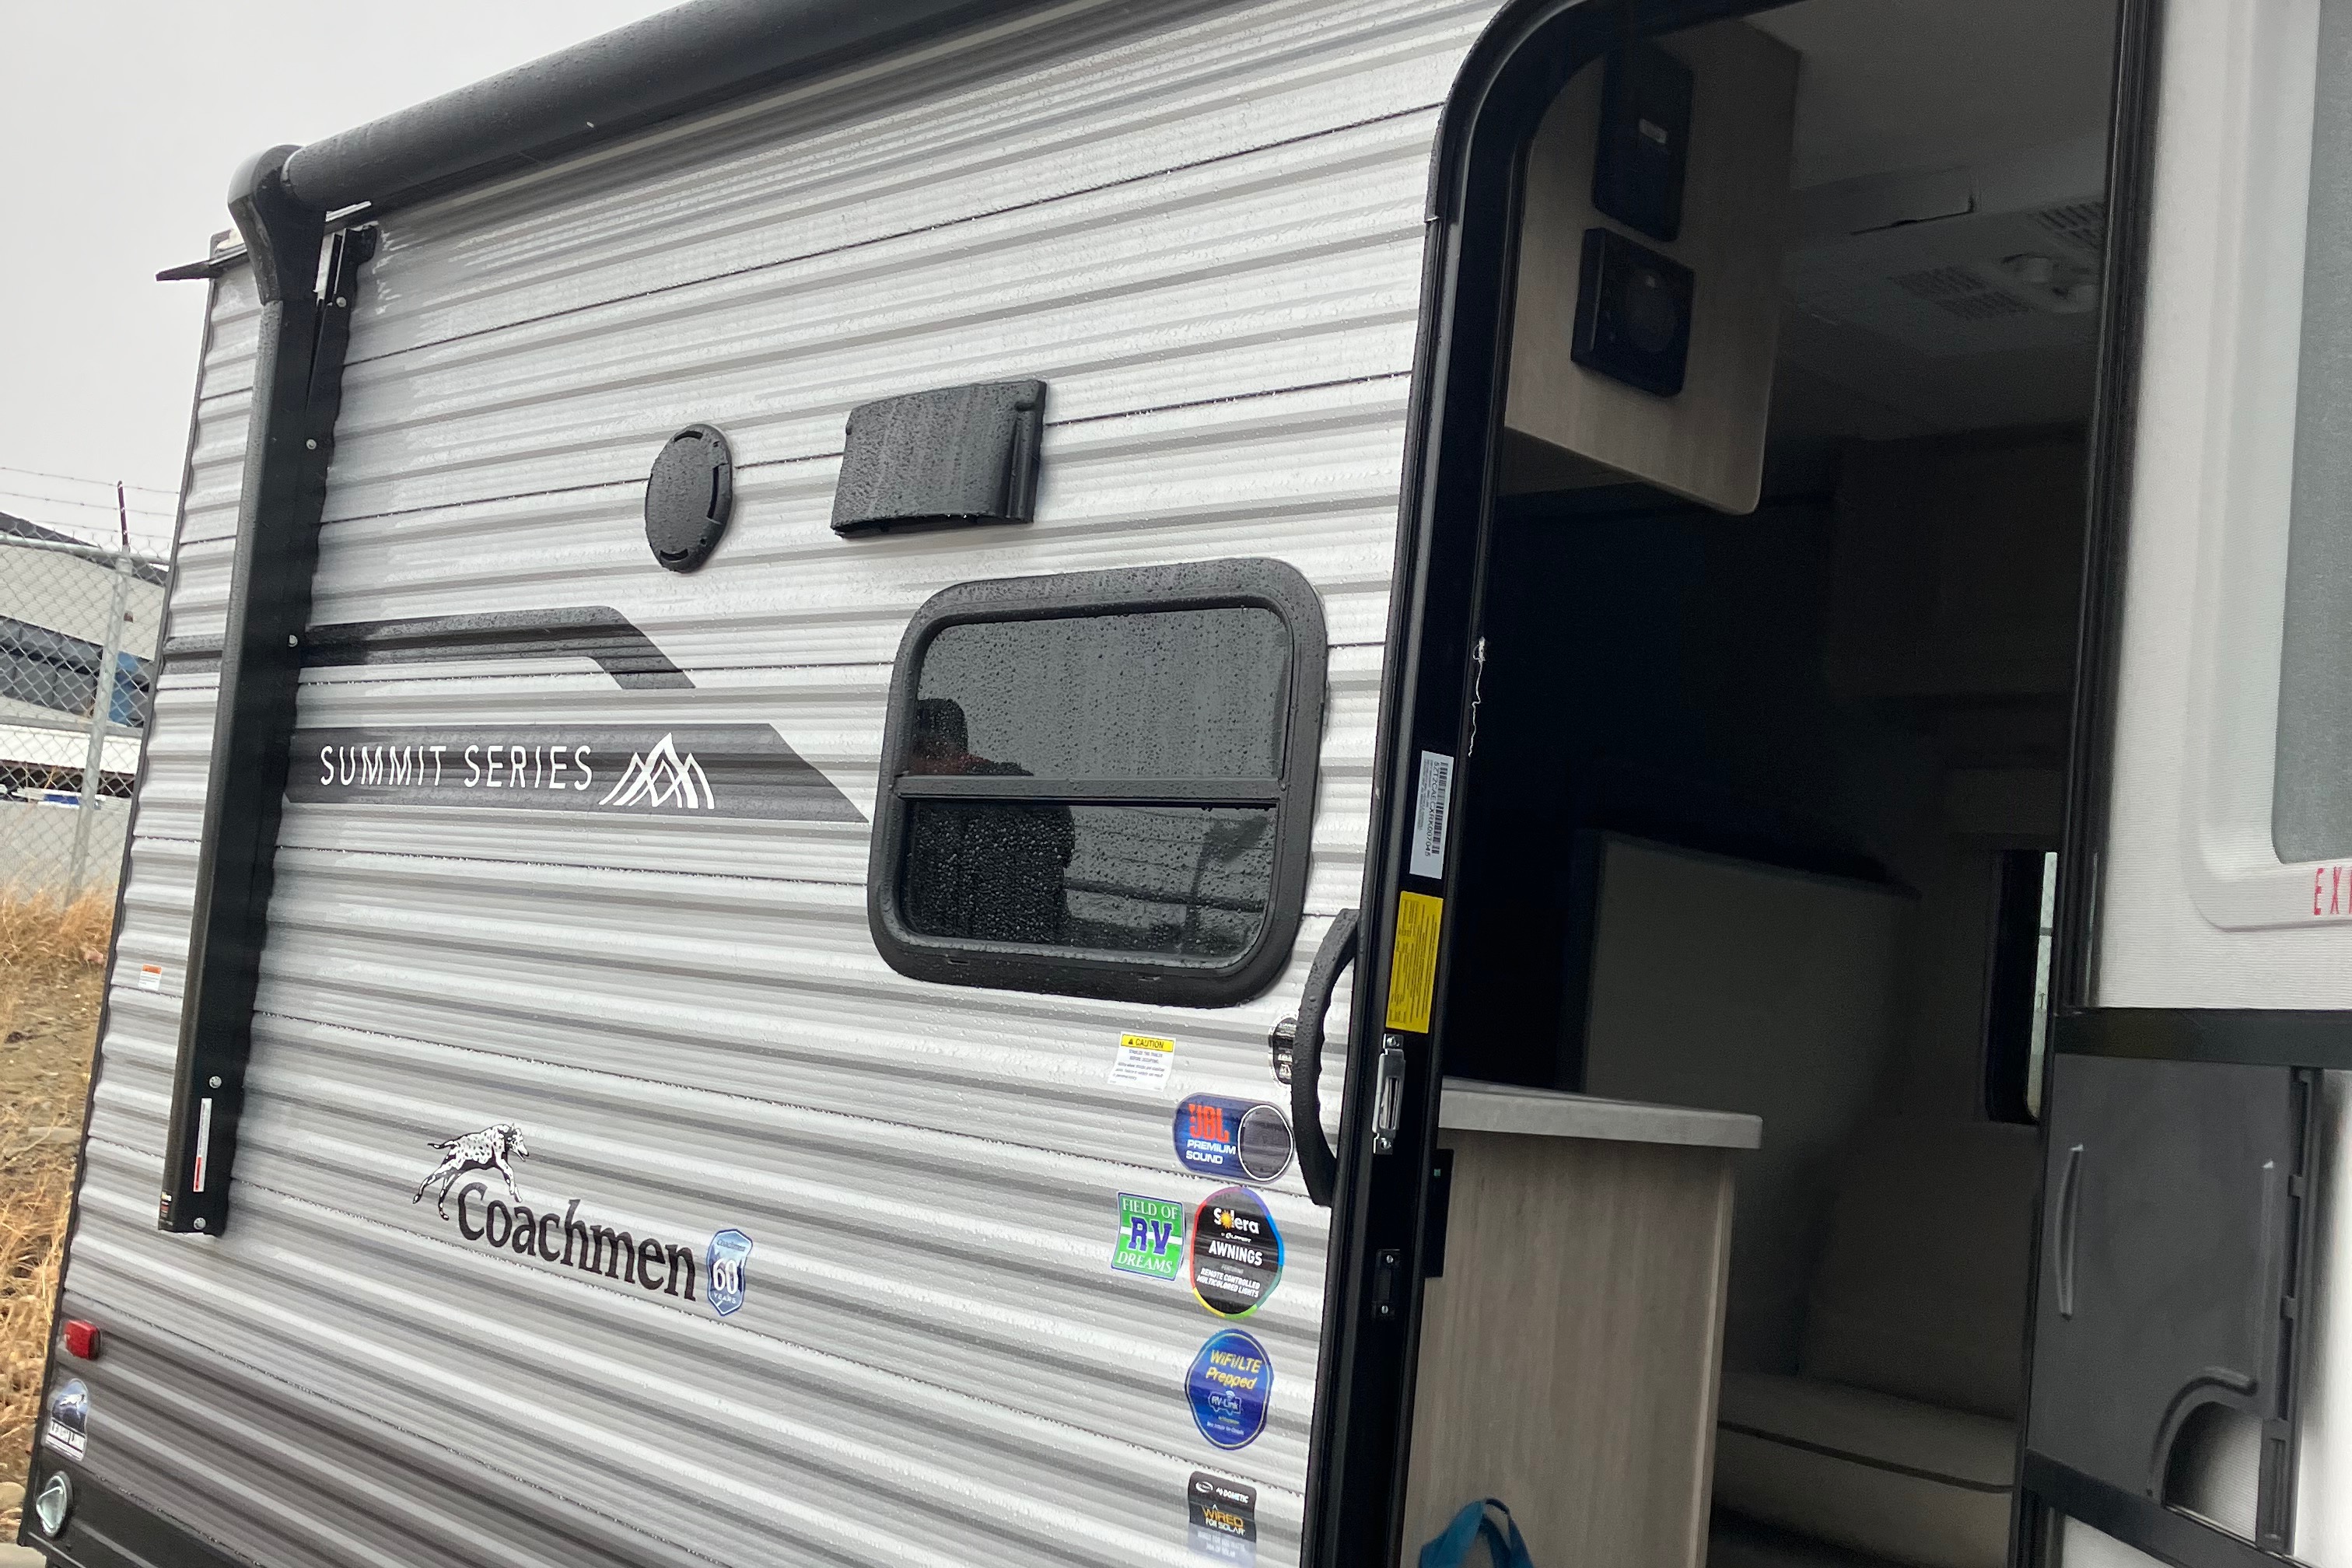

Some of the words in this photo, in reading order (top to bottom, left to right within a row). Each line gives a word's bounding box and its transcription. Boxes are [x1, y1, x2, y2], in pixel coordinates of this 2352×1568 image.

[320, 744, 446, 786] SUMMIT
[464, 744, 592, 792] SERIES
[1135, 1038, 1164, 1049] CAUTION
[1189, 1104, 1230, 1143] JBL
[1186, 1150, 1223, 1165] SOUND
[1187, 1139, 1237, 1156] PREMIUM
[1122, 1199, 1157, 1216] FIELD
[1160, 1205, 1178, 1220] OF
[1213, 1207, 1260, 1235] Solera
[457, 1182, 696, 1301] Coachmen
[1128, 1216, 1173, 1255] RV
[1117, 1251, 1173, 1274] DREAMS
[1209, 1240, 1263, 1266] AWNINGS
[713, 1258, 738, 1294] 60
[1200, 1267, 1224, 1280] REMOTE
[1223, 1274, 1260, 1290] CONTROLLED
[713, 1292, 736, 1304] YEARS
[1238, 1286, 1259, 1298] LIGHTS
[1206, 1367, 1258, 1390] Prepped
[1223, 1489, 1249, 1504] DOMETIC
[1201, 1506, 1244, 1529] WIRED
[1218, 1521, 1246, 1536] SOLAR
